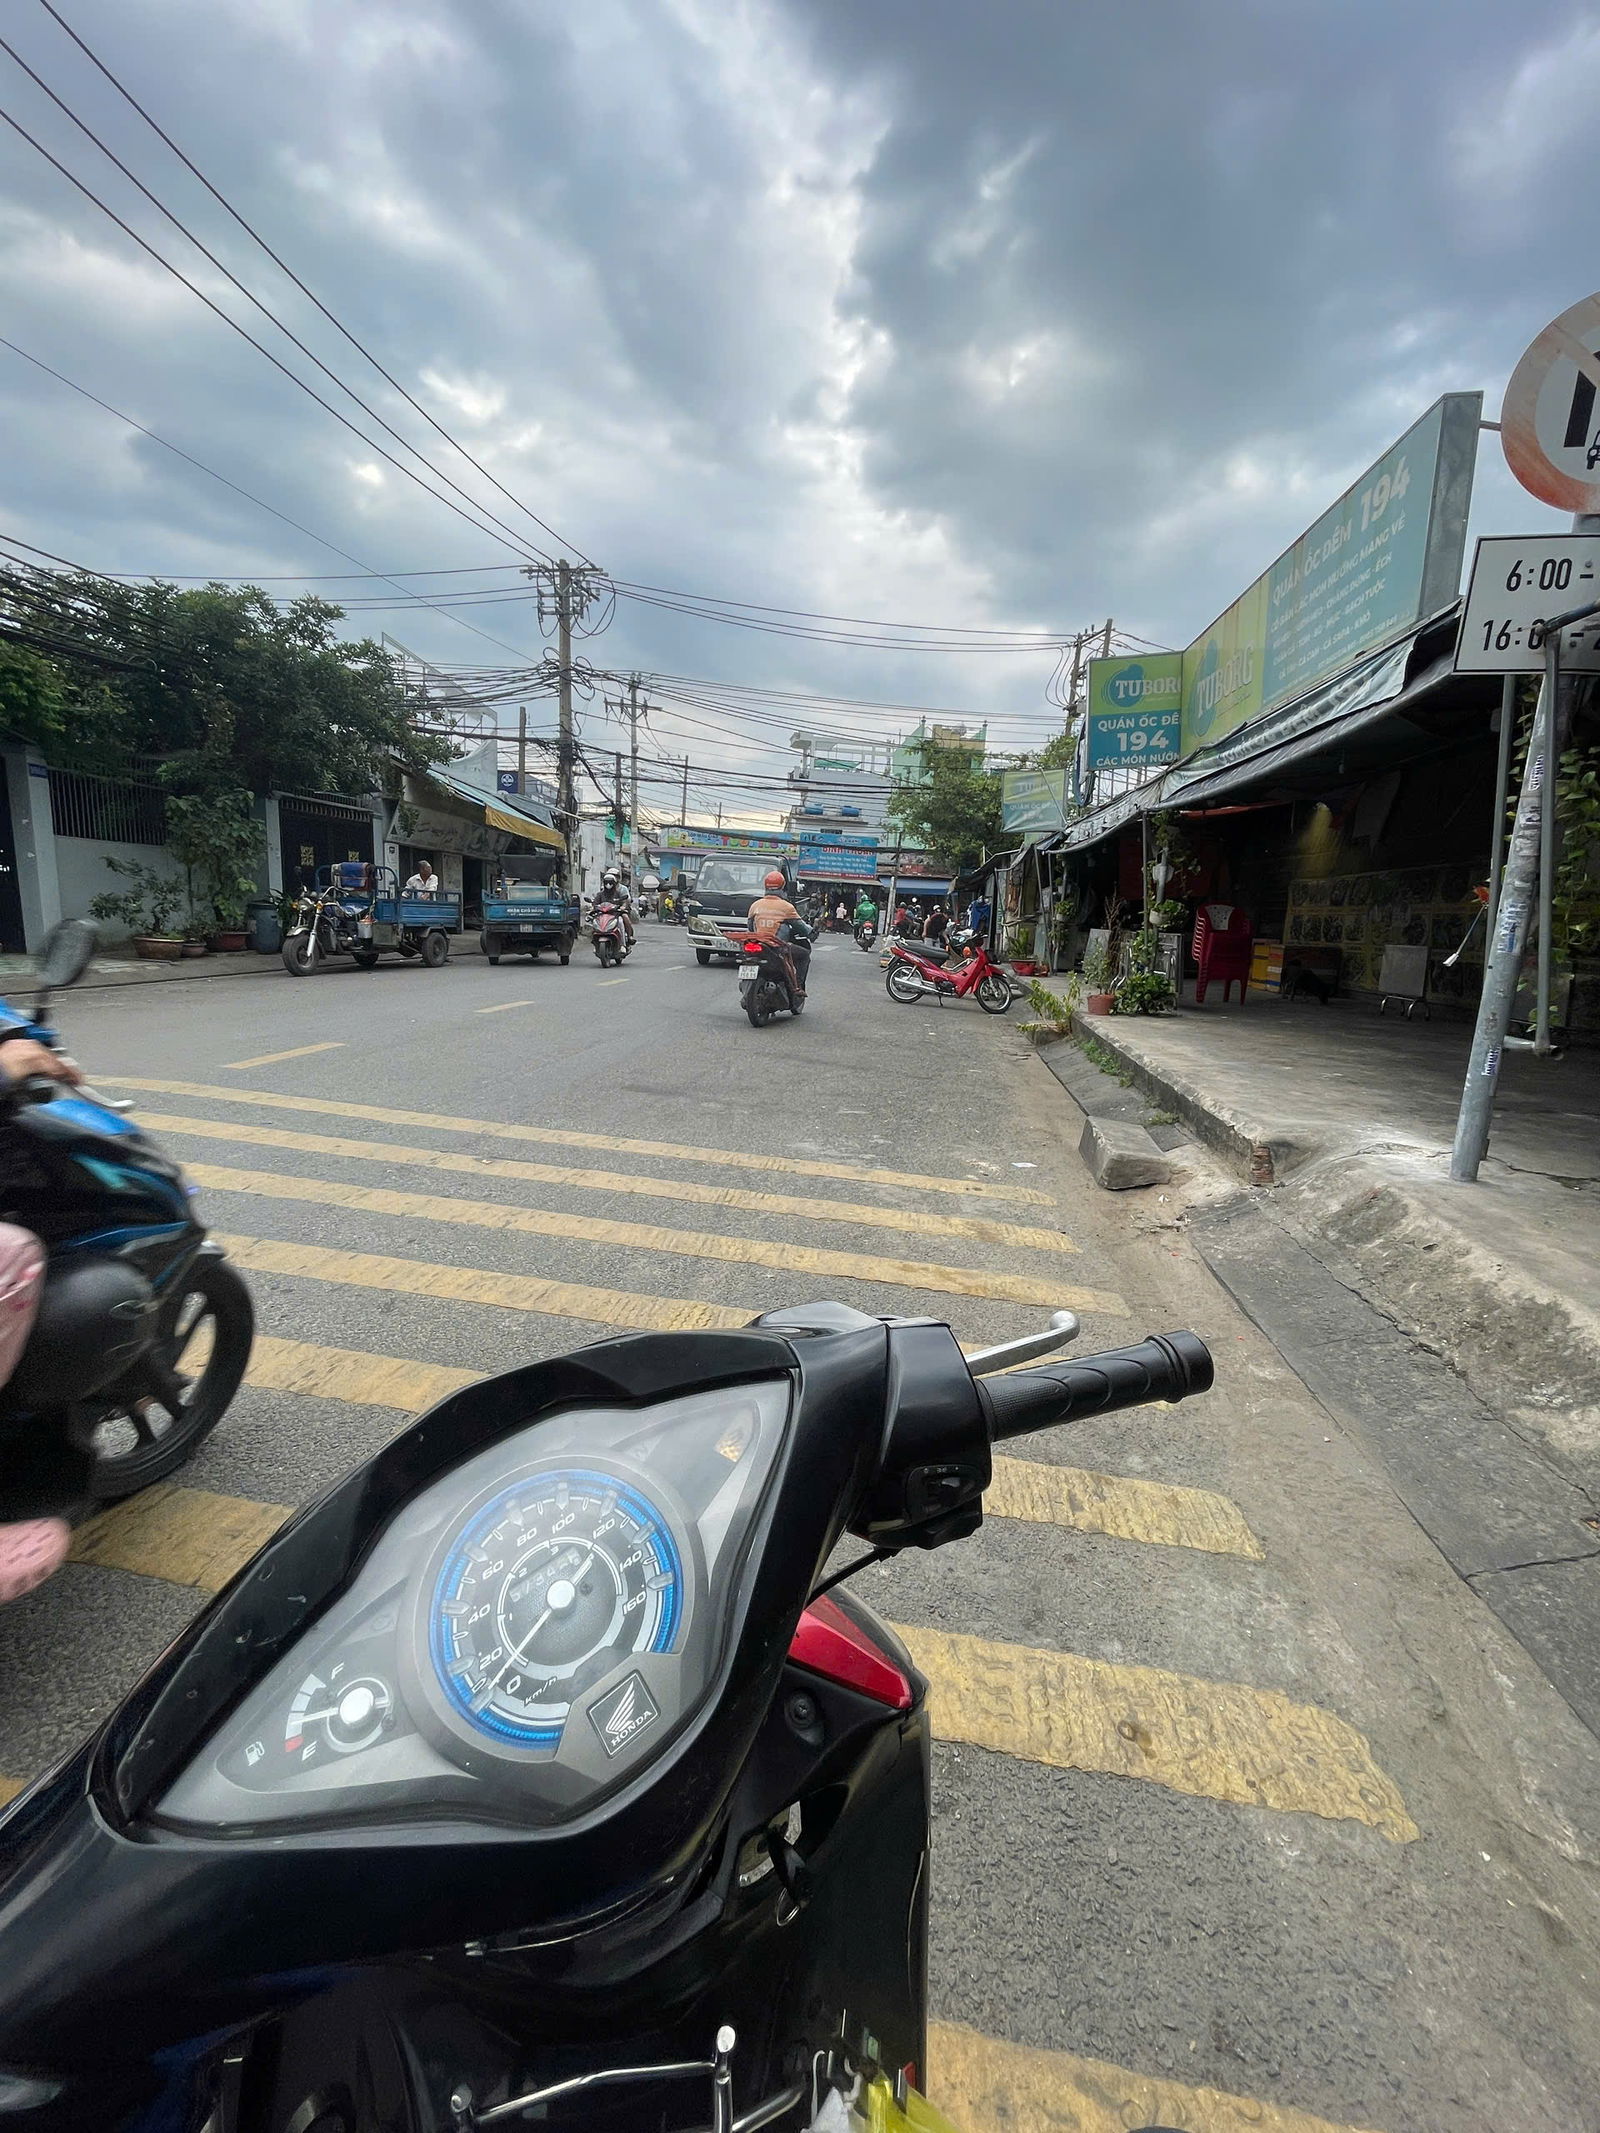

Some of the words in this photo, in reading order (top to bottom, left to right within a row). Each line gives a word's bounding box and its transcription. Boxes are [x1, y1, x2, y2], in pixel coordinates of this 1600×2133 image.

[1361, 456, 1411, 532] 194
[1359, 529, 1389, 559] MANG
[1506, 559, 1572, 592] 6:00
[1483, 619, 1547, 651] 16:0
[1196, 646, 1254, 718] TUBORG
[1098, 715, 1134, 730] QUÁN
[1139, 713, 1157, 726] ỐC
[1162, 711, 1181, 725] ĐÊ
[1117, 730, 1169, 751] 194
[1096, 756, 1118, 767] CÁC
[1121, 754, 1147, 765] MÓN
[552, 1513, 575, 1534] 100
[592, 1519, 615, 1539] 120
[517, 1528, 537, 1547] 80
[482, 1560, 504, 1580] 60
[620, 1550, 643, 1572] 140
[519, 1568, 527, 1578] 2
[623, 1591, 647, 1614] 160
[468, 1604, 490, 1624] 40
[479, 1647, 502, 1670] 20
[331, 1662, 344, 1680] F
[506, 1675, 521, 1695] 0
[611, 1710, 653, 1747] HONDA
[302, 1740, 318, 1761] E
